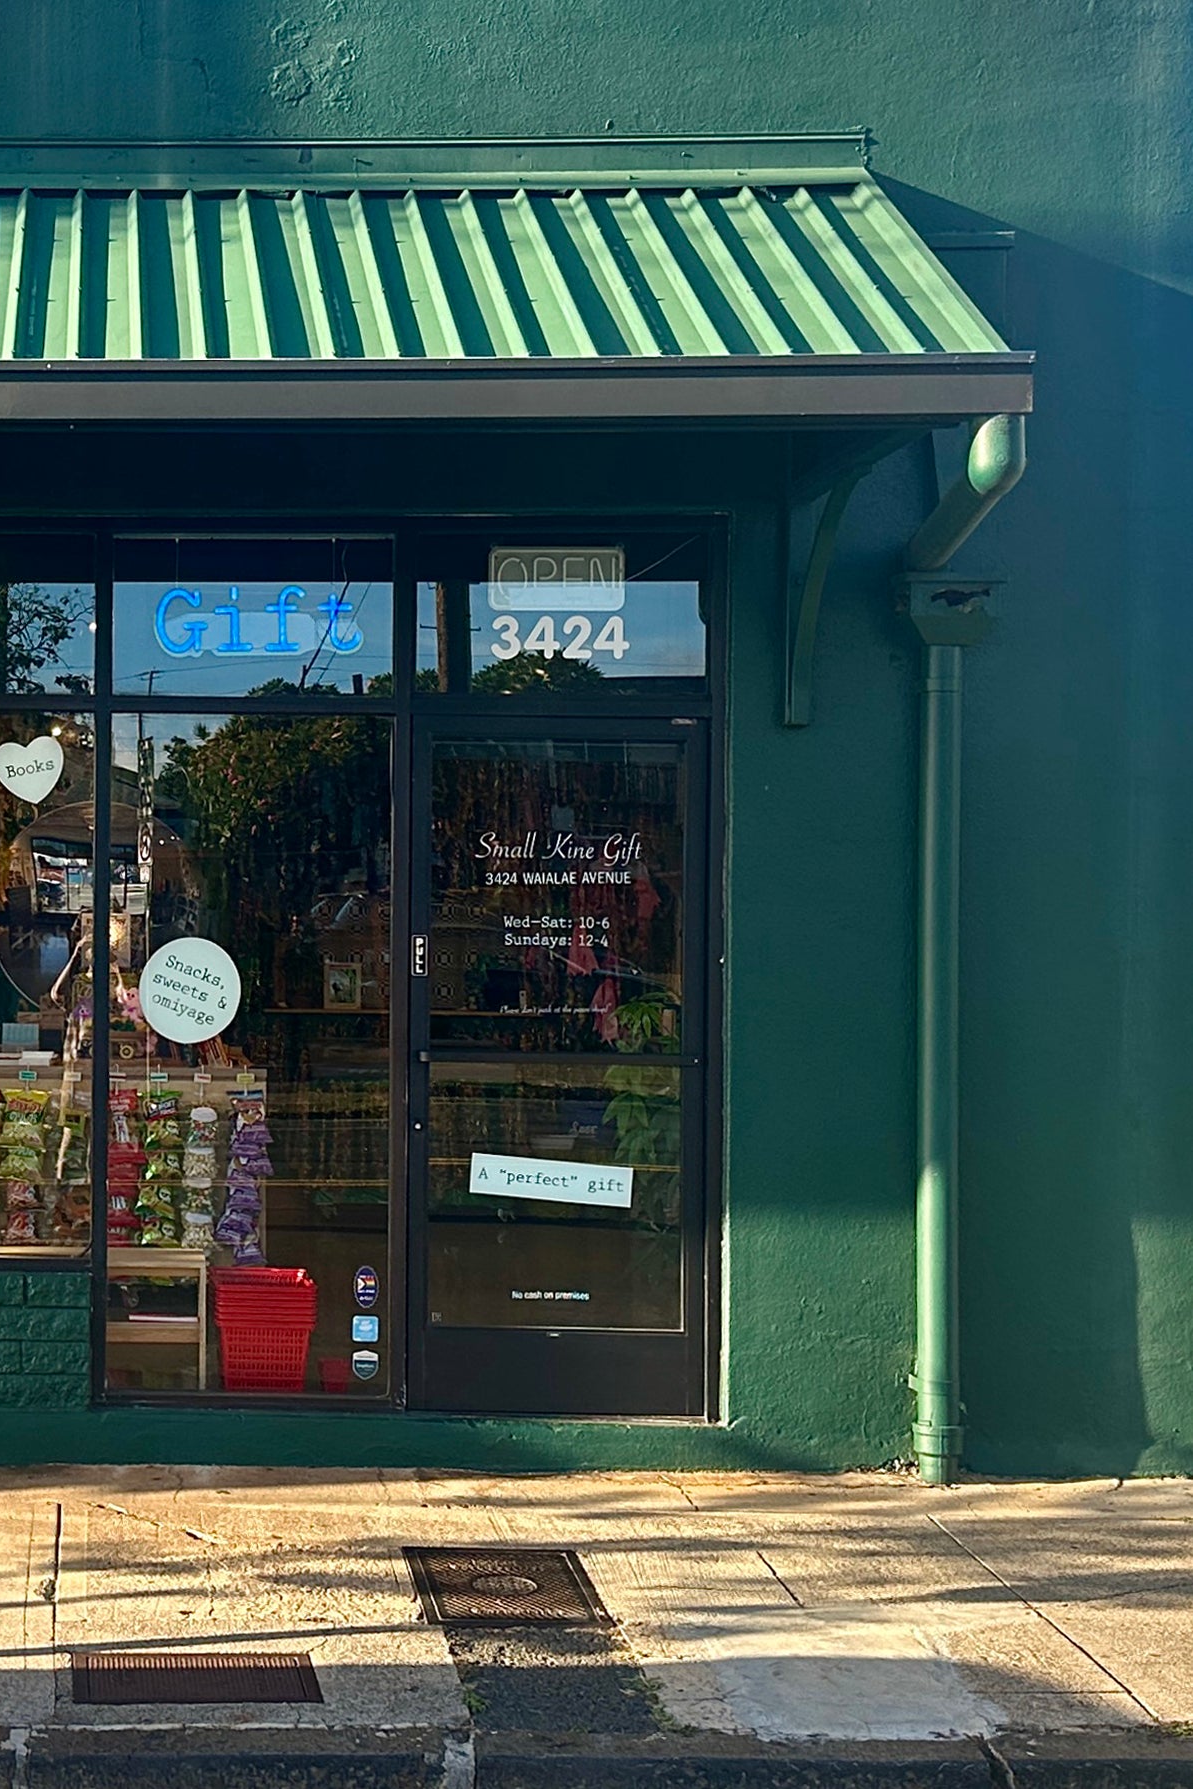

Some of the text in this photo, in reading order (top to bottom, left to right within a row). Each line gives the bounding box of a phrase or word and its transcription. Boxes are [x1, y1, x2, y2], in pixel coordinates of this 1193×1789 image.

[497, 556, 617, 600] OPEN
[154, 584, 364, 657] Gift
[491, 614, 631, 660] 3424
[6, 758, 55, 779] Books
[474, 831, 644, 867] Small Kine Gift
[485, 871, 632, 885] 3424 WAIALAE AVENUE
[579, 916, 610, 929] 10-6
[415, 937, 424, 973] PULL
[503, 934, 609, 948] Sundays: 12-4
[165, 954, 225, 990] Snacks,
[152, 972, 227, 1010] sweets &
[151, 992, 215, 1027] omiyage
[477, 1167, 624, 1194] A "perfect" gift
[511, 1290, 590, 1300] No cash on premises
